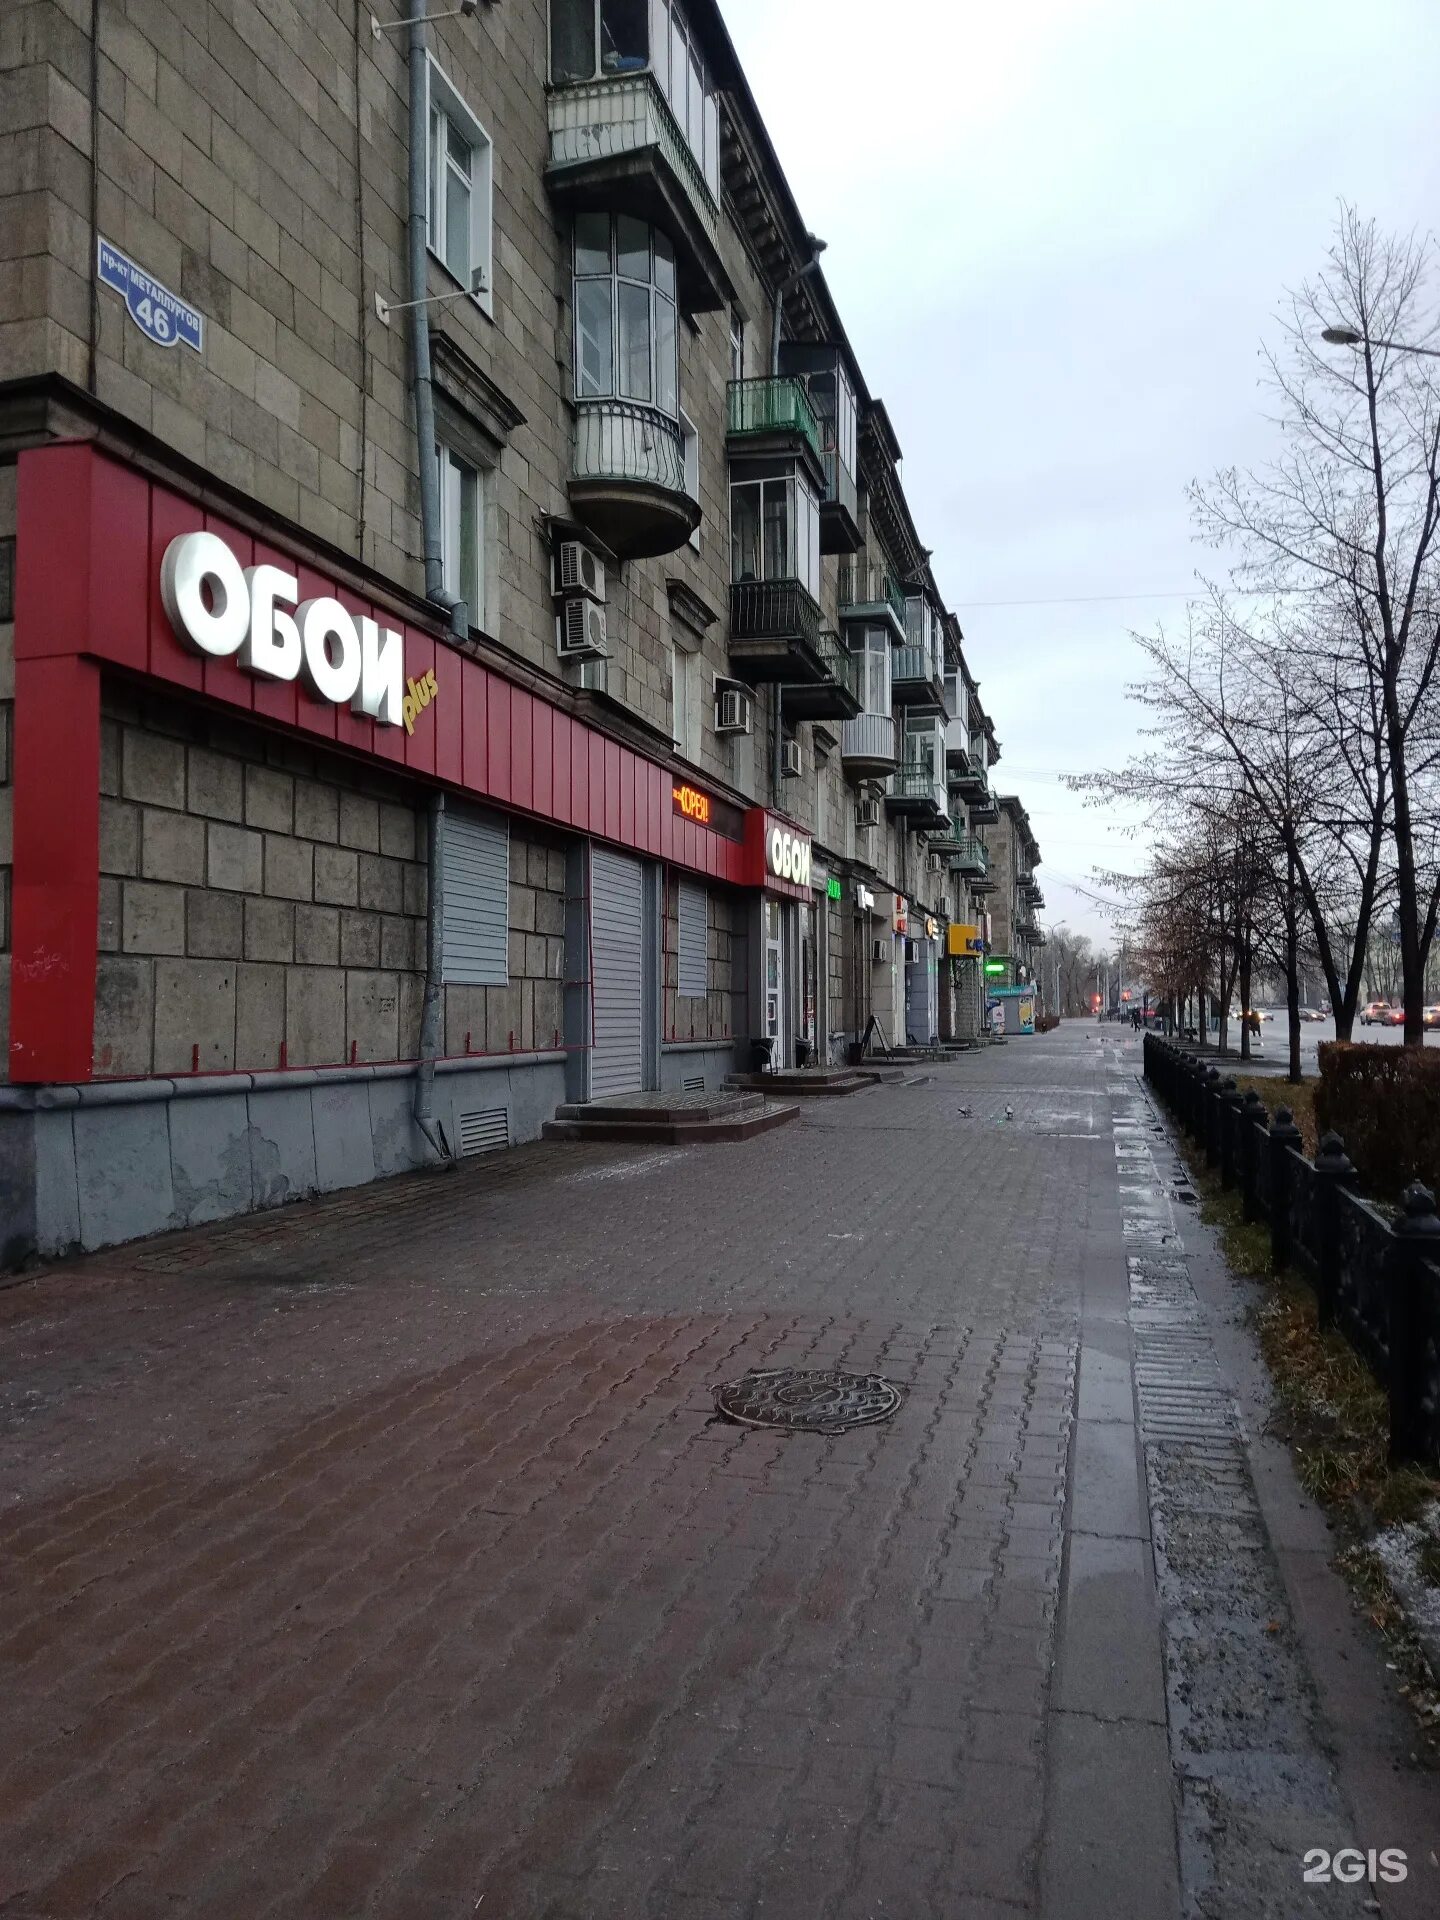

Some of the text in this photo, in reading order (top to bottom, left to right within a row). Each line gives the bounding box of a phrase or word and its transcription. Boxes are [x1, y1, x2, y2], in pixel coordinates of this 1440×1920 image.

[102, 250, 199, 332] пр-кт МЕТАЛЛУРГОВ
[136, 298, 169, 339] 46
[160, 531, 404, 728] ОБОИ
[402, 668, 439, 736] plus
[767, 827, 811, 887] ОБОИ
